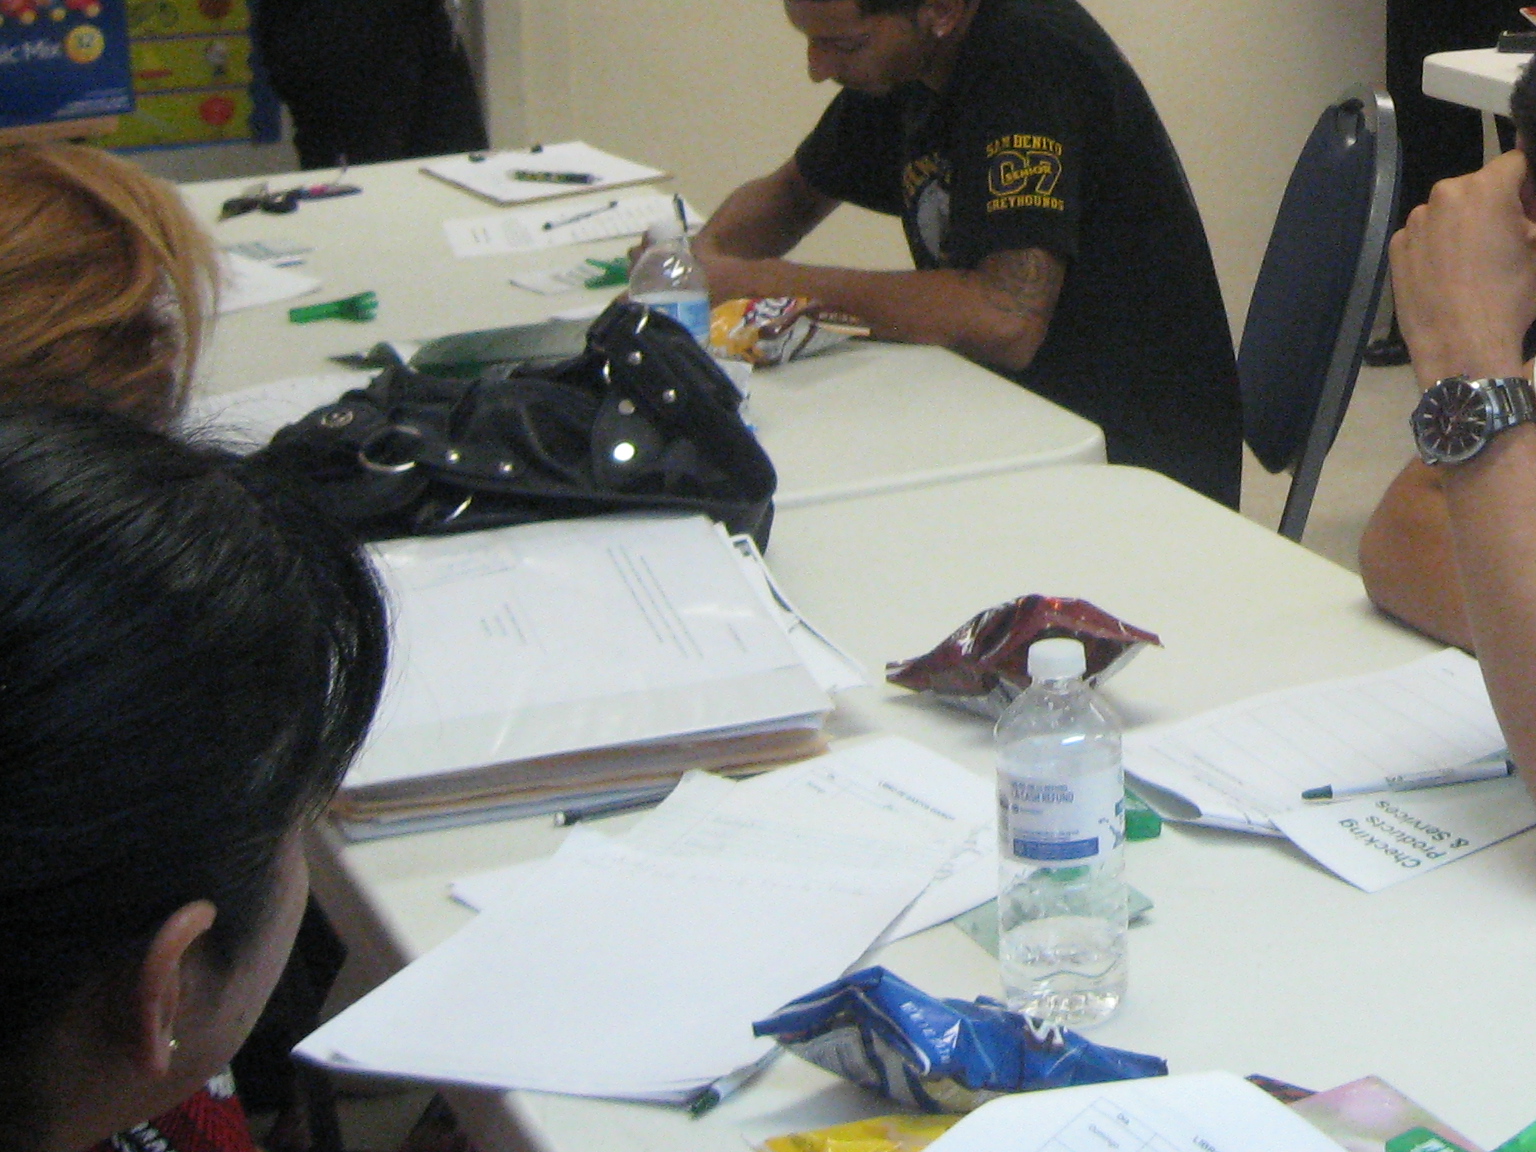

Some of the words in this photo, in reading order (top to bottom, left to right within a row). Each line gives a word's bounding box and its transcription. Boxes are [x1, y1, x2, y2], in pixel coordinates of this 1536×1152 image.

[1012, 133, 1064, 156] BENITO
[1005, 164, 1052, 182] SENIOR
[986, 195, 1065, 213] GREYHOUNDS
[1375, 800, 1452, 841] Services
[1338, 818, 1422, 868] Checking
[1365, 815, 1447, 860] Products
[1450, 837, 1470, 849] &
